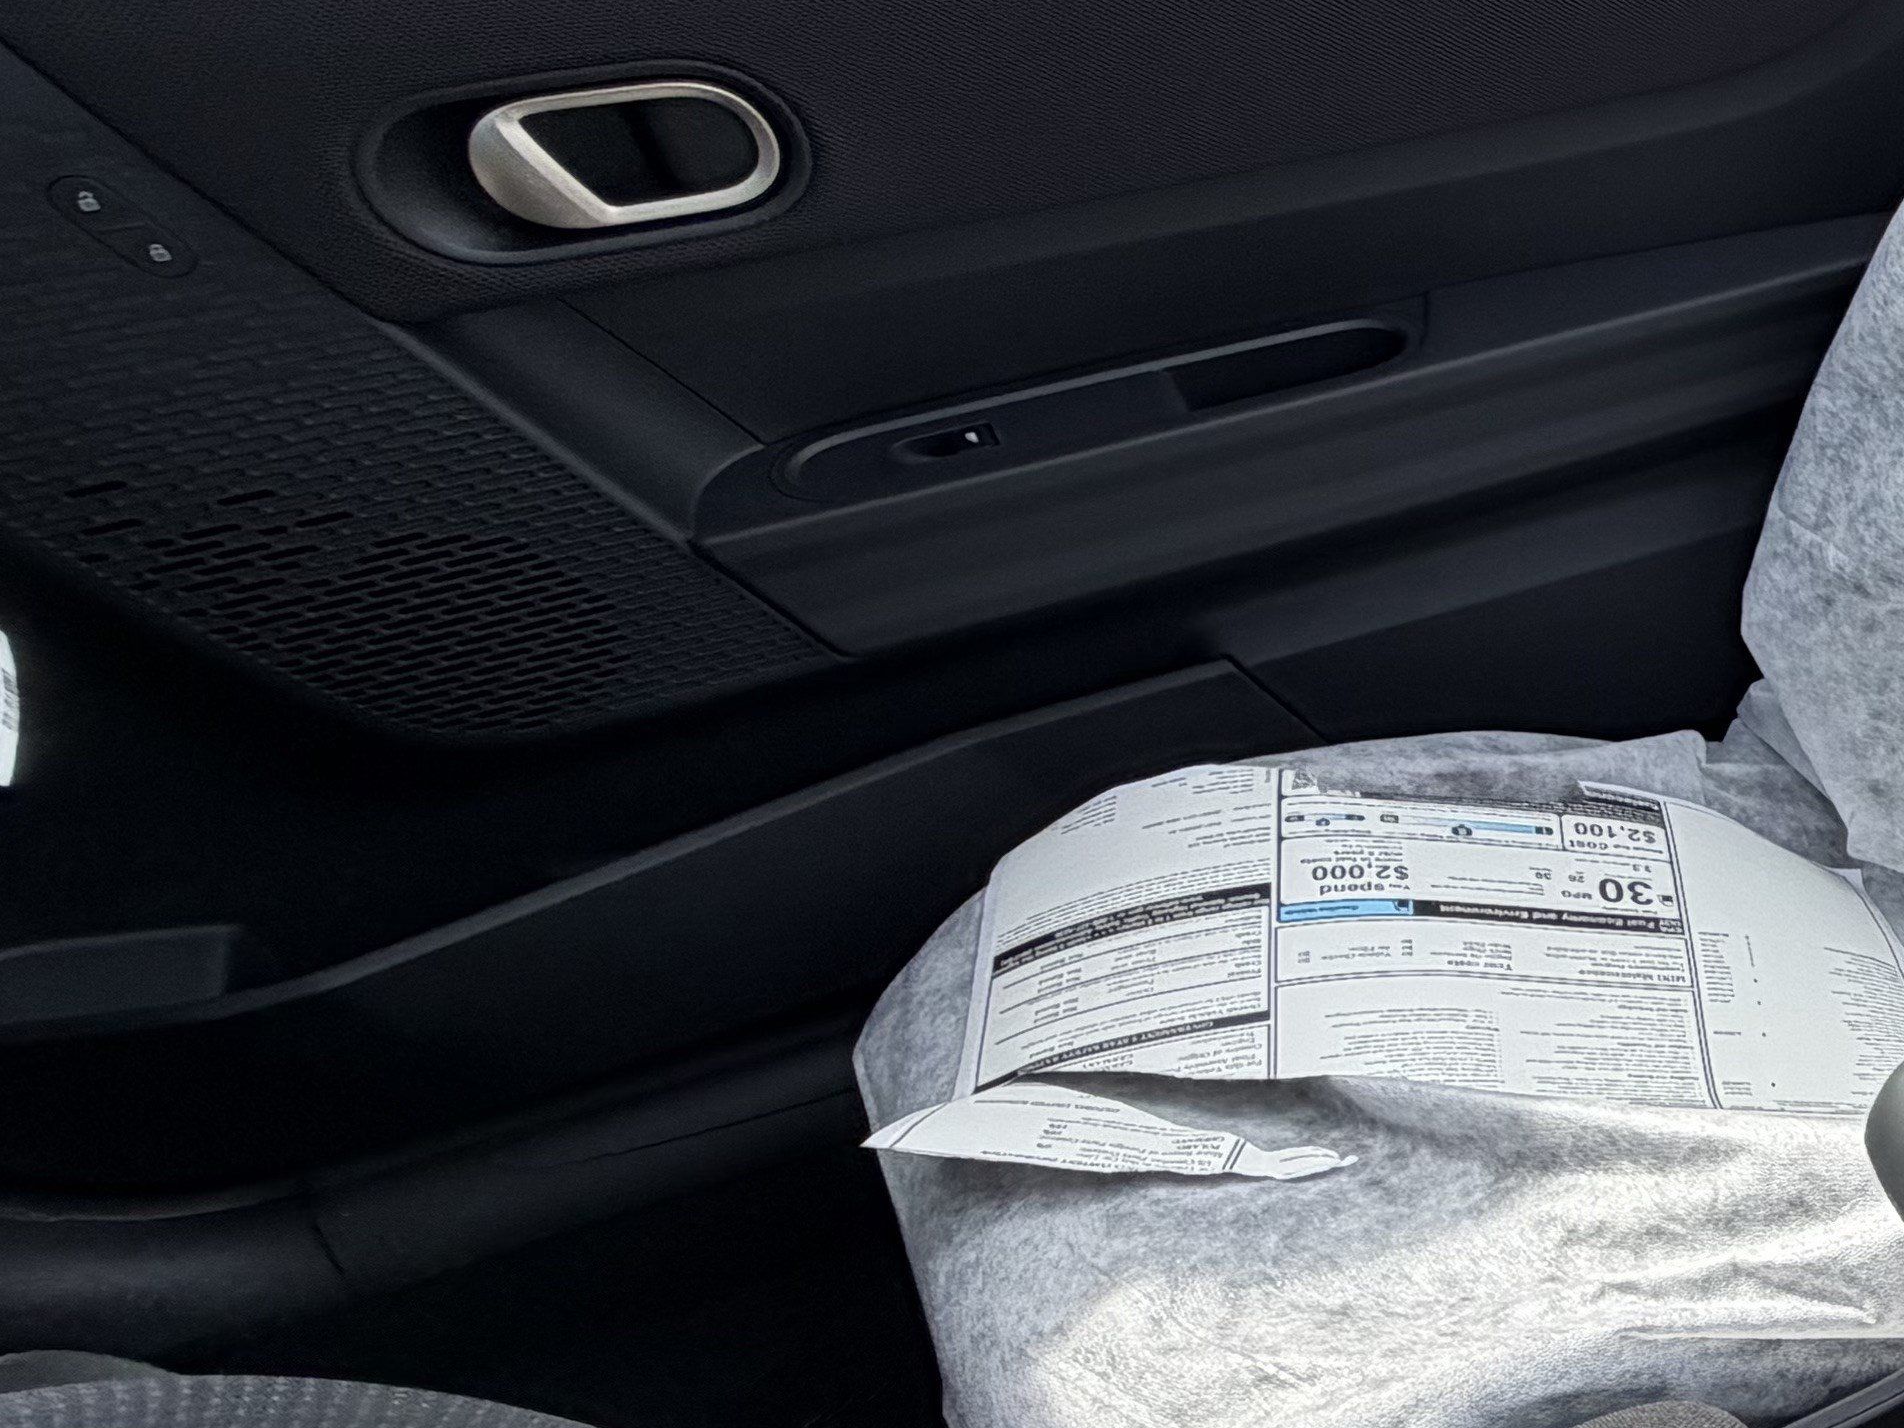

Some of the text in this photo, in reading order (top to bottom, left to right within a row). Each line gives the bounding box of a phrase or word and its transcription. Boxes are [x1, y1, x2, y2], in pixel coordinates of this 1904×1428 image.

[1572, 820, 1656, 843] $2,100
[1310, 861, 1409, 884] $2,000
[1318, 881, 1384, 895] spend
[1560, 877, 1655, 906] 30 MPG
